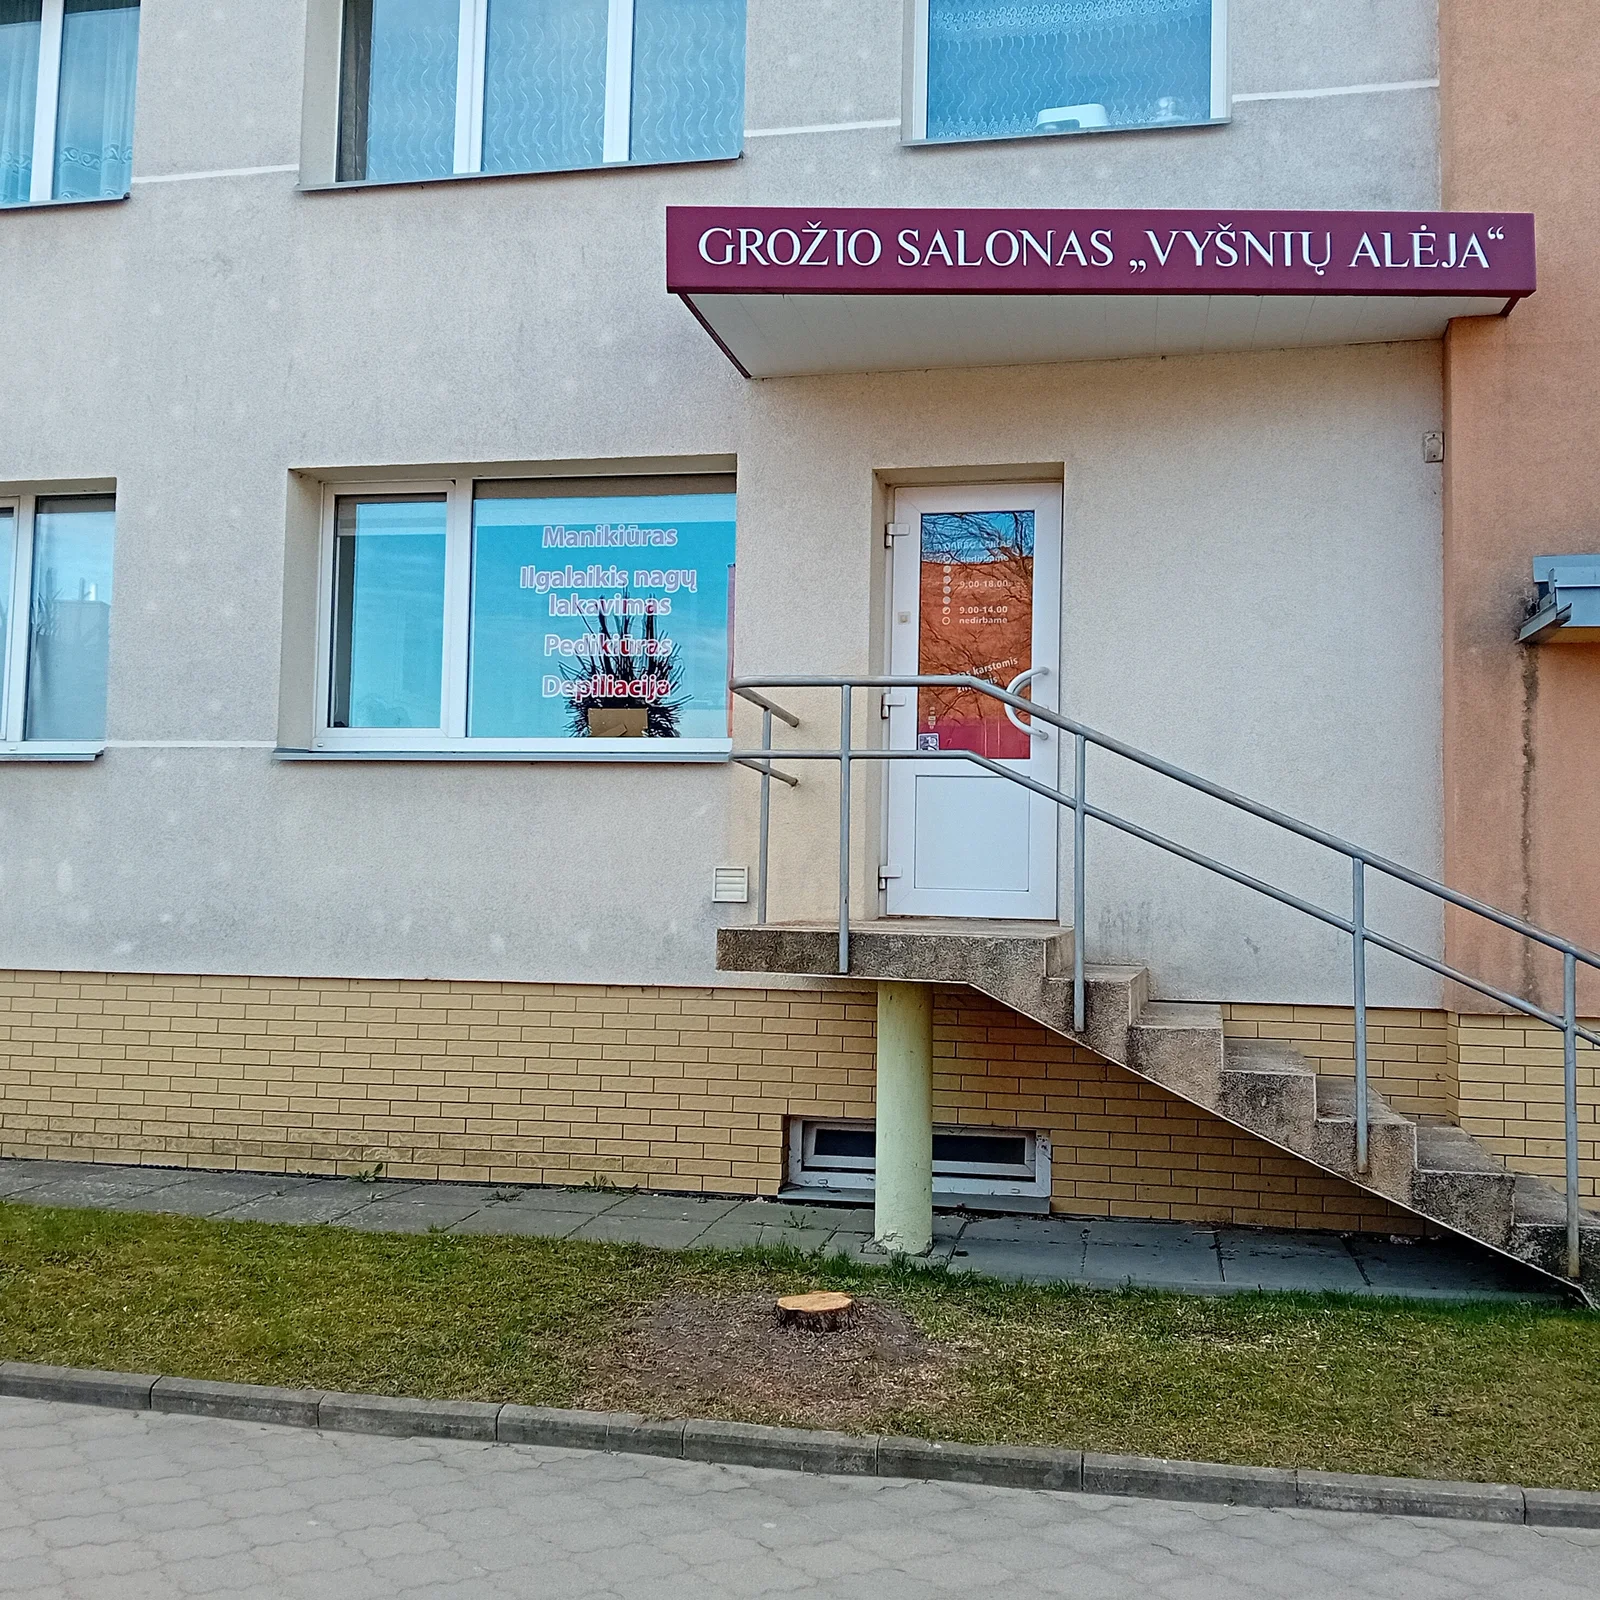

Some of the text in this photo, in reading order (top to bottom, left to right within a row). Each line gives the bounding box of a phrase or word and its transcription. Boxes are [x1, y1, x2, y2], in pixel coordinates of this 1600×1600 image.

[697, 221, 1506, 276] GROŽIO SALONAS „VYŠNIŲ ALĖJA“
[543, 525, 678, 548] Manikiūras
[521, 566, 698, 593] Ilgalaikis nagų
[549, 594, 671, 616] lakavimas
[959, 606, 1008, 614] 9.00-14.00
[959, 616, 1008, 624] nedirbame
[544, 634, 672, 656] Pedikiūras
[542, 675, 671, 701] Depiliacija
